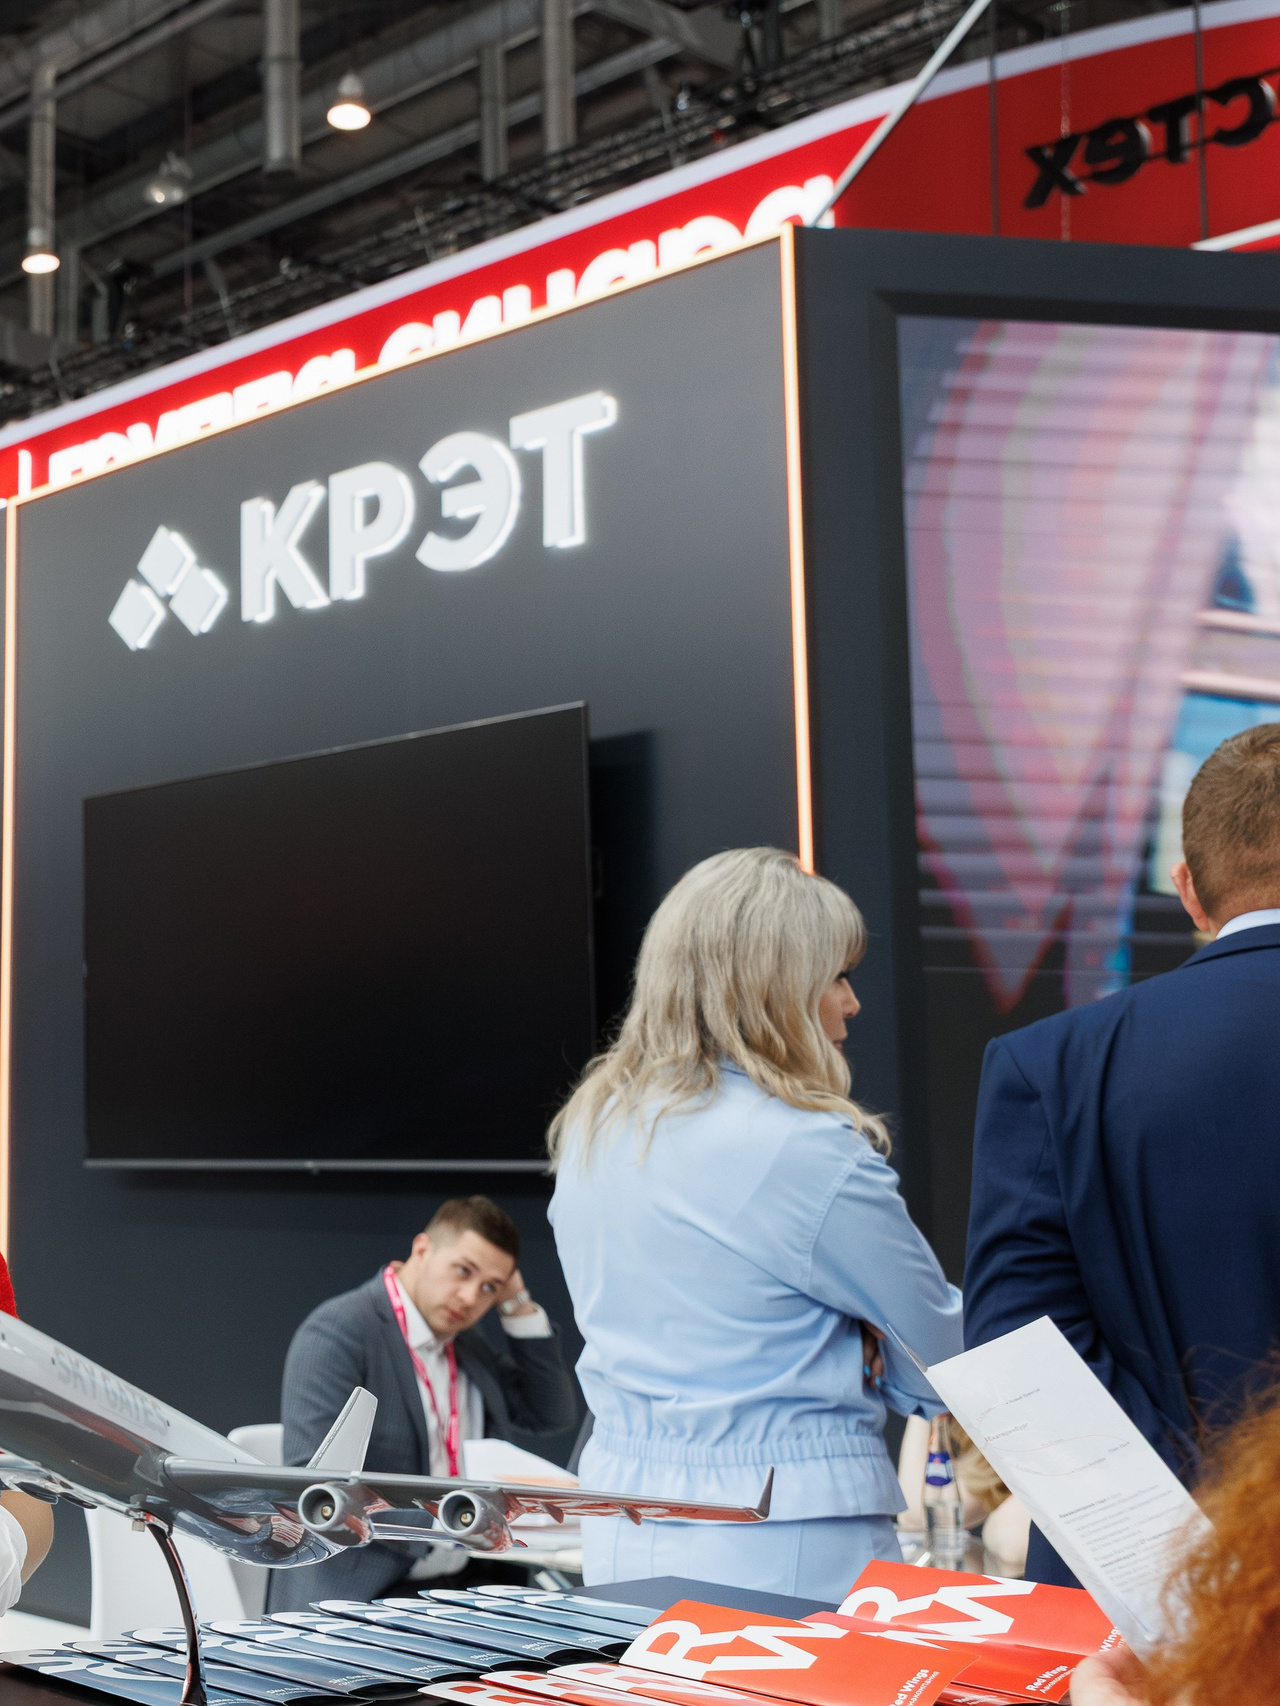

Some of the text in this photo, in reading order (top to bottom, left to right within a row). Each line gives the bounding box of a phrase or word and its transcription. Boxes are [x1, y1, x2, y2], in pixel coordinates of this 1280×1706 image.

[240, 389, 619, 625] КРЭТ
[889, 1669, 930, 1706] ed Wings
[907, 1670, 940, 1706] иакомпания
[1025, 1664, 1069, 1692] Red Wings
